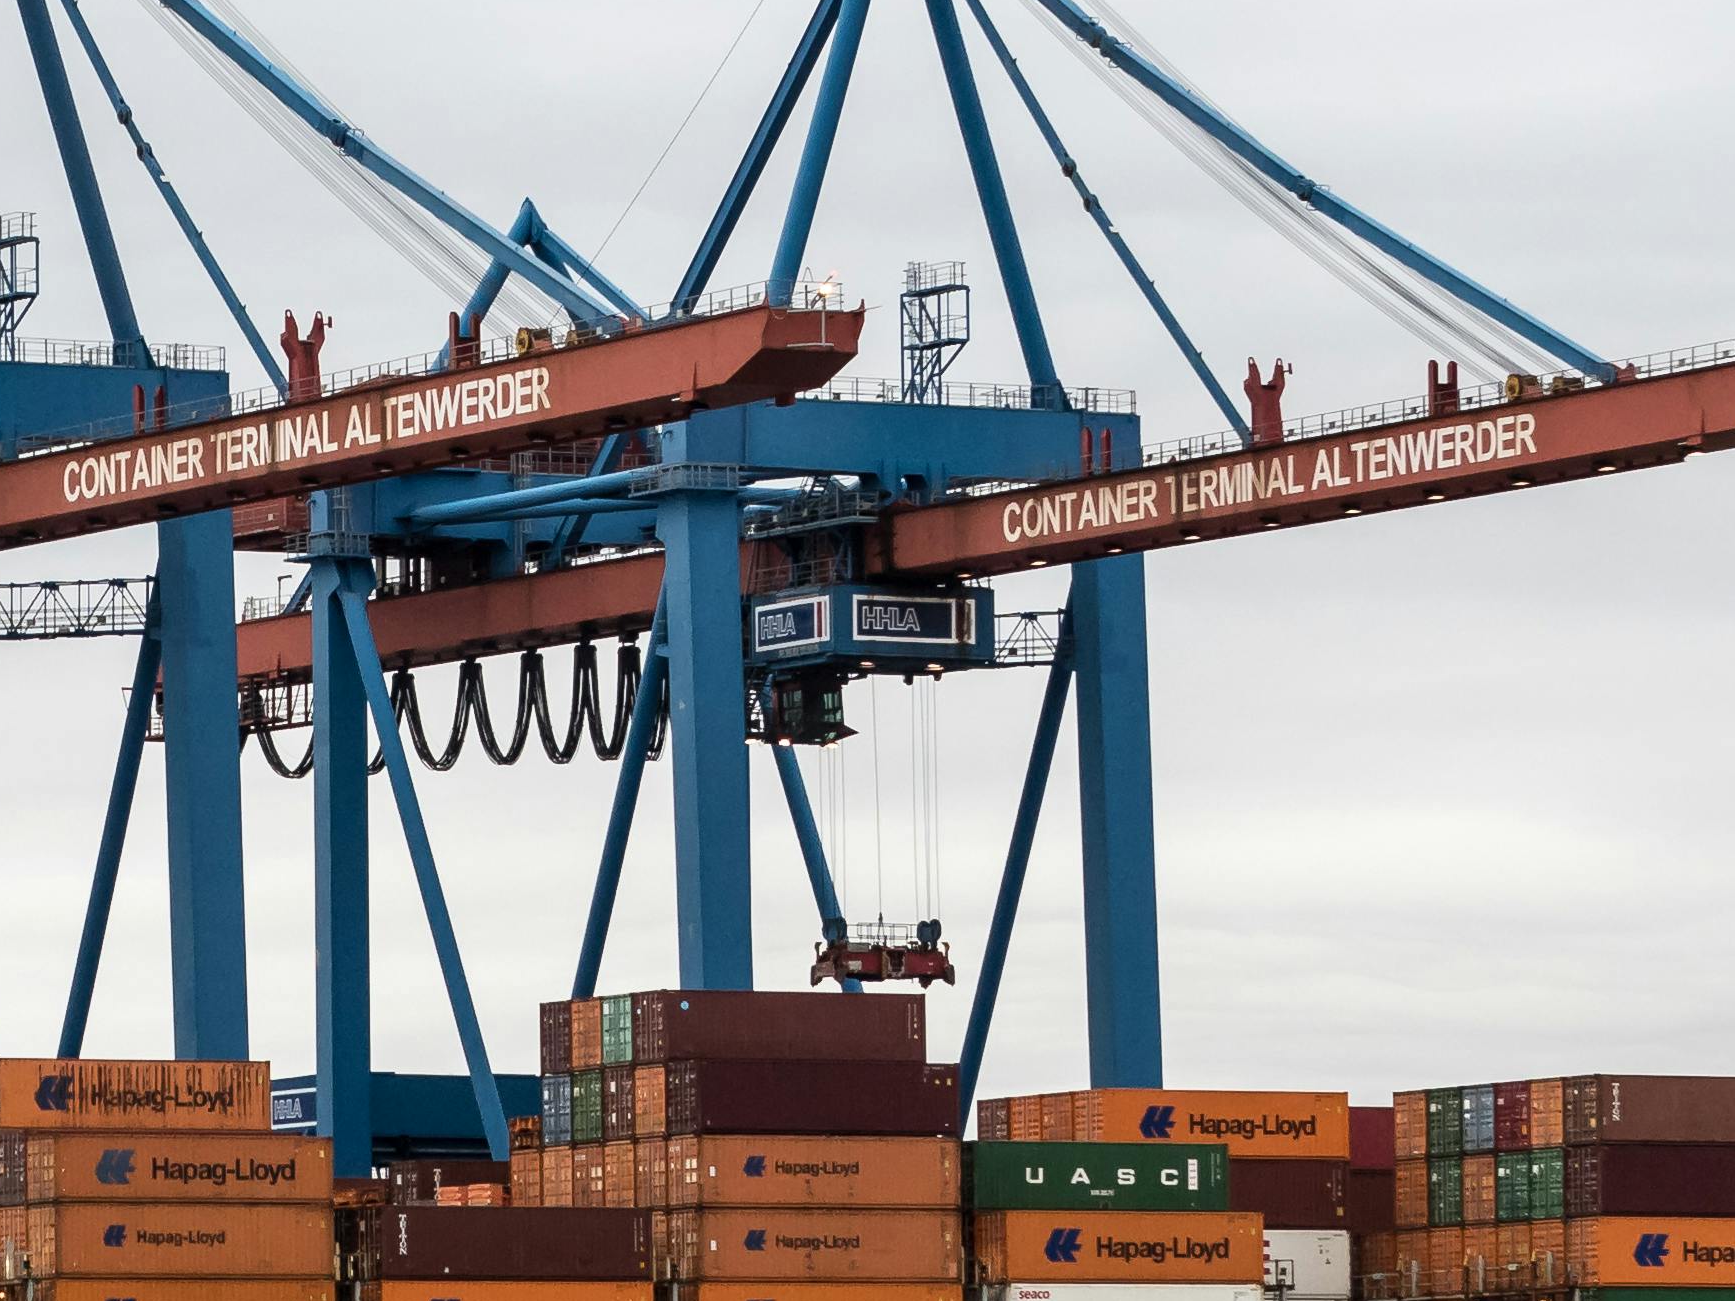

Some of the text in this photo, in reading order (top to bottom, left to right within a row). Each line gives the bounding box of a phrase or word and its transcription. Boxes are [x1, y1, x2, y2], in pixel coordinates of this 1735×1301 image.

[63, 367, 550, 503] CONTAINER TERMINAL ALTENWERDER
[1004, 413, 1536, 543] CONTAINER TERMINAL ALTENWERDER
[760, 612, 796, 640] HHLA
[862, 605, 920, 632] HHLA
[91, 1086, 233, 1111] Hapag-Lloyd
[1189, 1113, 1316, 1140] Hapag-Lloyd
[152, 1157, 296, 1186] Hapag-Lloyd
[775, 1160, 859, 1177] Hapag-Lloyd
[137, 1230, 225, 1248] Hapag-Lloyd
[776, 1234, 860, 1251] Hapag-Lloyd
[1096, 1237, 1229, 1263] Hapag-Lloyd
[1019, 1290, 1050, 1300] seaco
